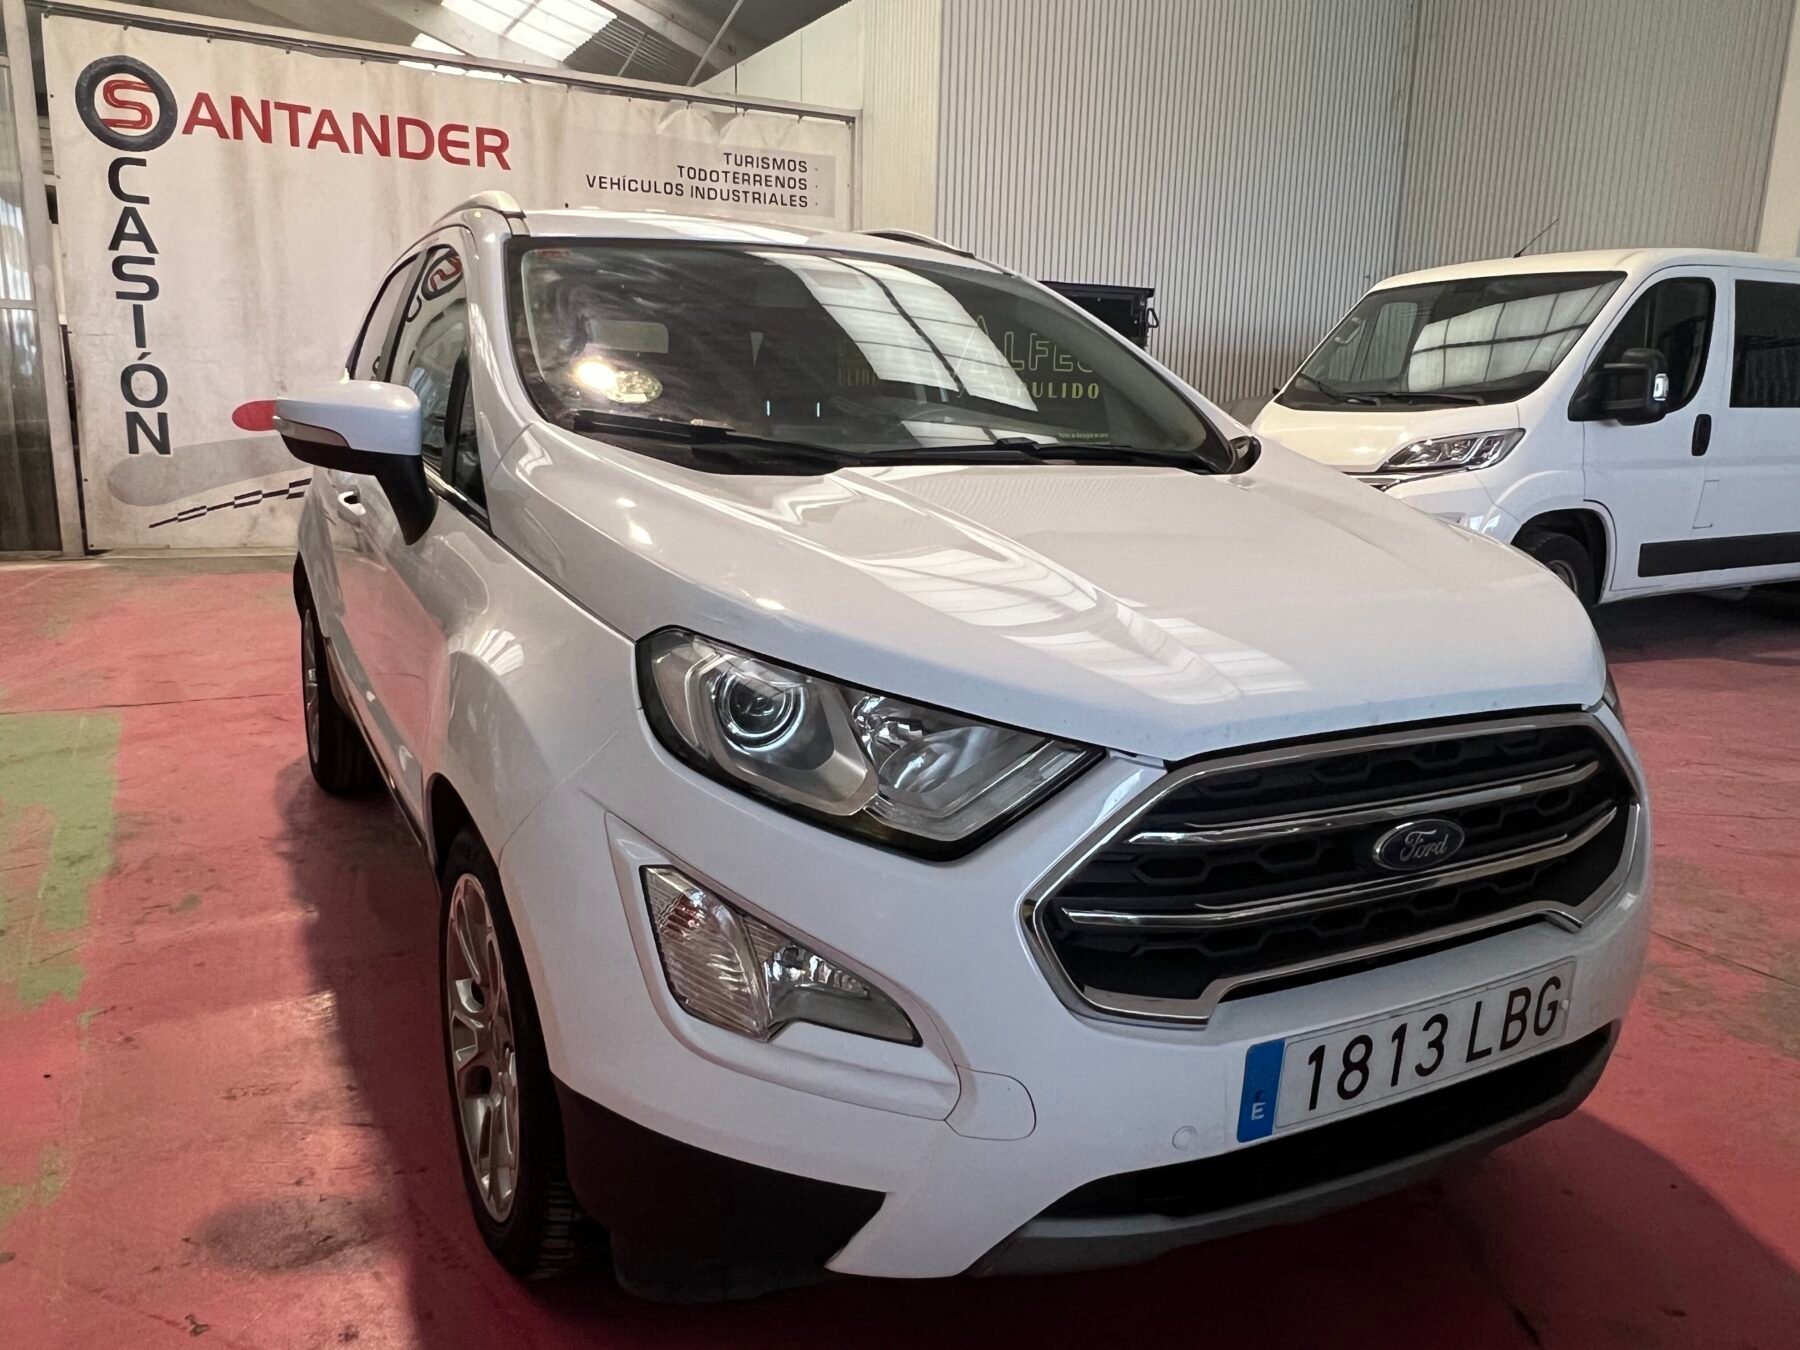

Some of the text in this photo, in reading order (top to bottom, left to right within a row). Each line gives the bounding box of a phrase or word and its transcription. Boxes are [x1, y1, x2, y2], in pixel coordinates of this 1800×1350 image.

[723, 152, 809, 173] TURISMOS
[586, 174, 809, 208] VEHÍCULOS INDUSTRIALES
[677, 165, 808, 191] TODOTERRENOS
[1400, 829, 1449, 861] Ford
[1308, 976, 1561, 1111] 1813 LBG
[1250, 1101, 1267, 1122] E
